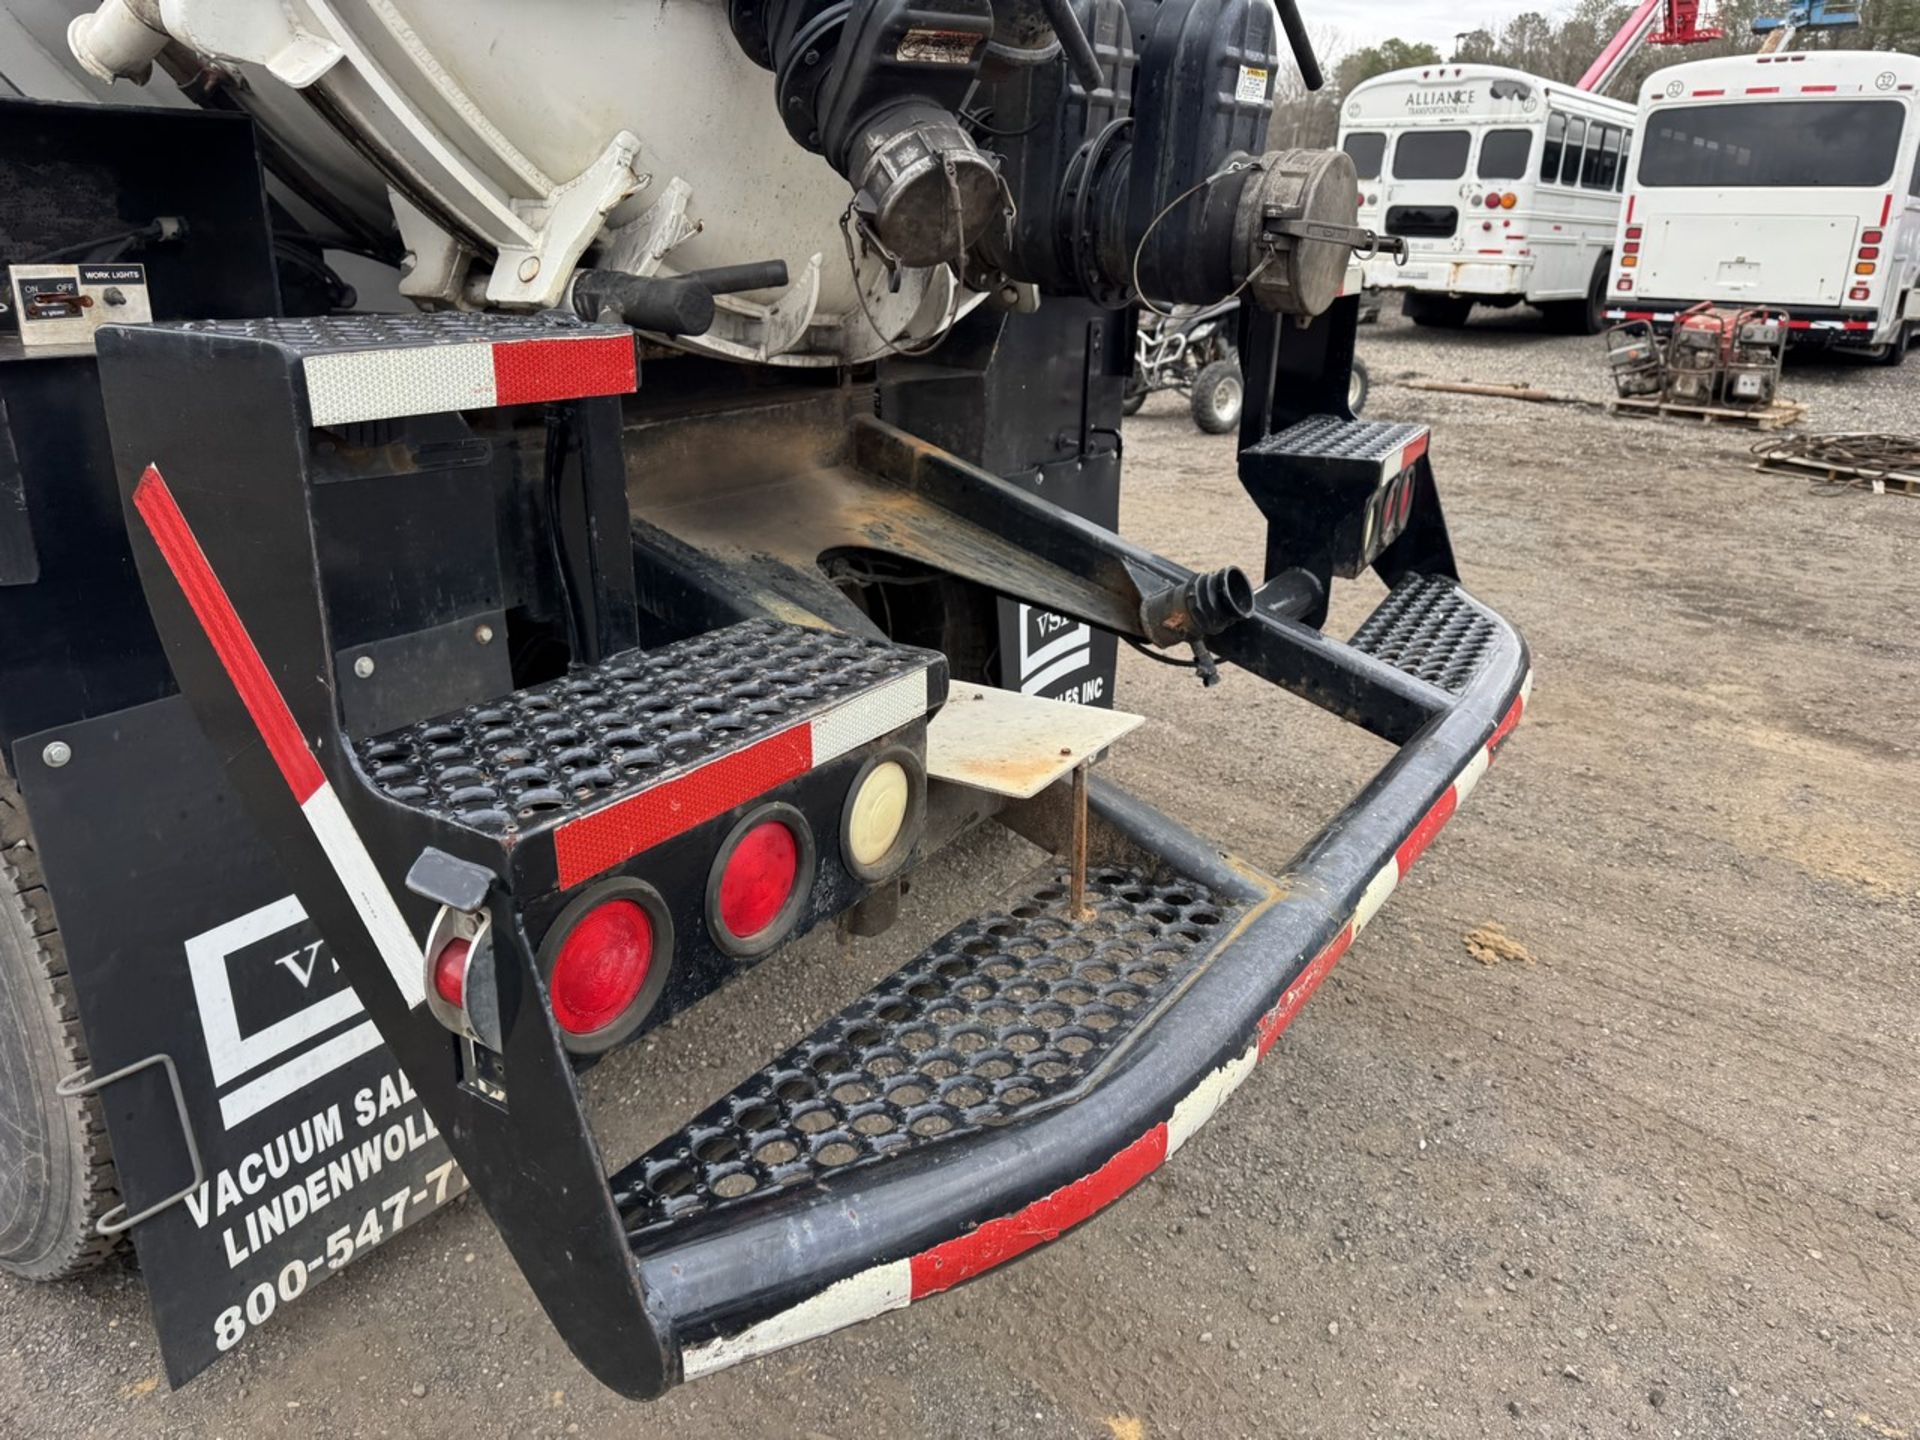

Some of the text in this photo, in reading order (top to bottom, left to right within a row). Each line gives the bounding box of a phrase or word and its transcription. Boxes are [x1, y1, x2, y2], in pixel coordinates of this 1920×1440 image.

[1405, 90, 1475, 106] ALLIANCE
[85, 271, 139, 280] WORK LIGHTS
[25, 284, 73, 293] ON OFF
[1082, 677, 1103, 704] INC
[184, 1103, 344, 1229] VACUUM
